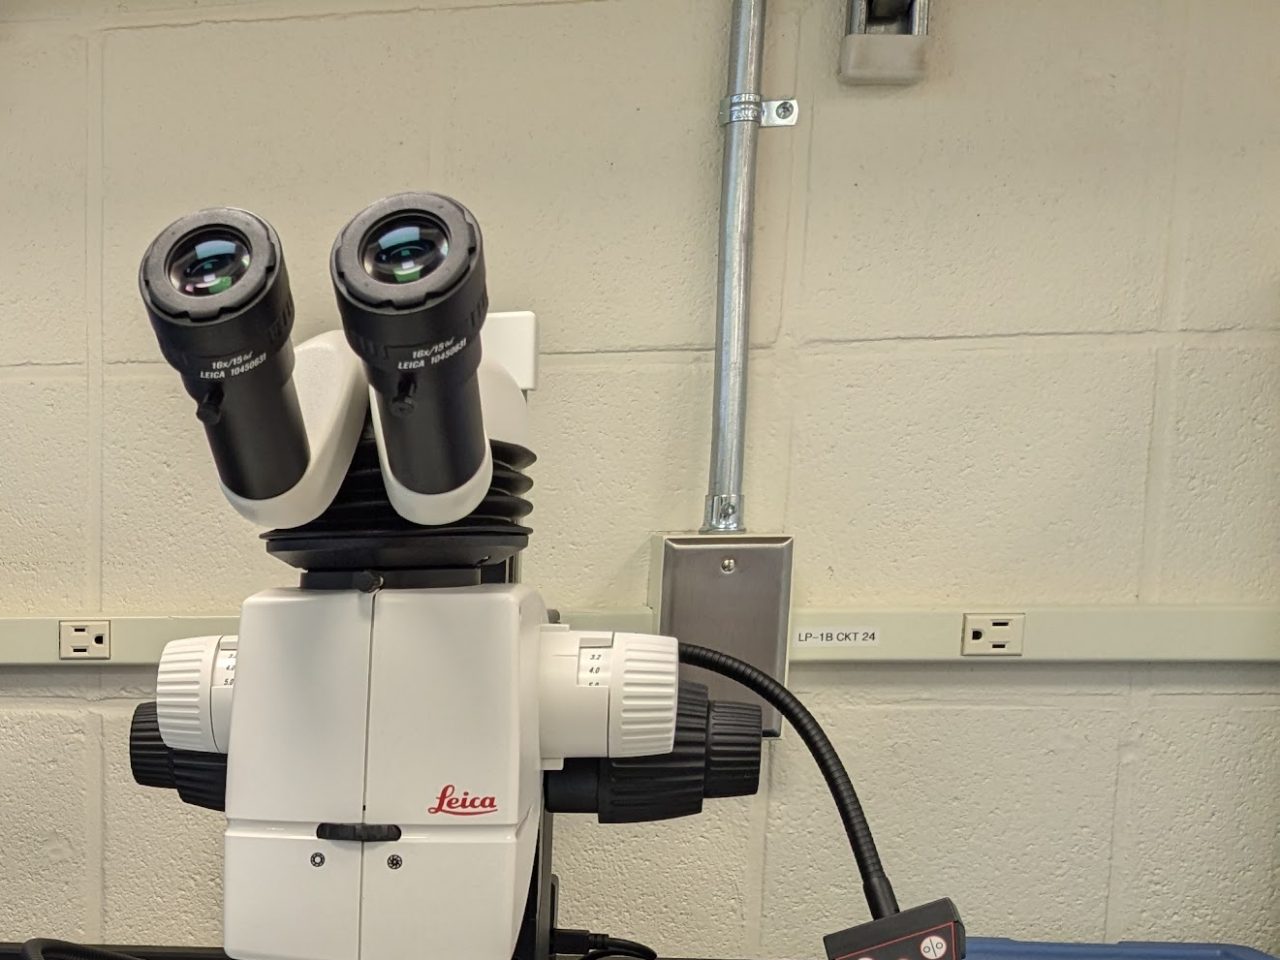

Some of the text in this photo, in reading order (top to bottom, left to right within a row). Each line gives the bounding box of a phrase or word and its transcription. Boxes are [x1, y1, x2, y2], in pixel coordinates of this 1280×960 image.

[397, 360, 425, 370] LEICA
[200, 370, 225, 379] LEICA
[798, 632, 876, 642] LP-1B CKT 24
[427, 784, 498, 816] Leica
